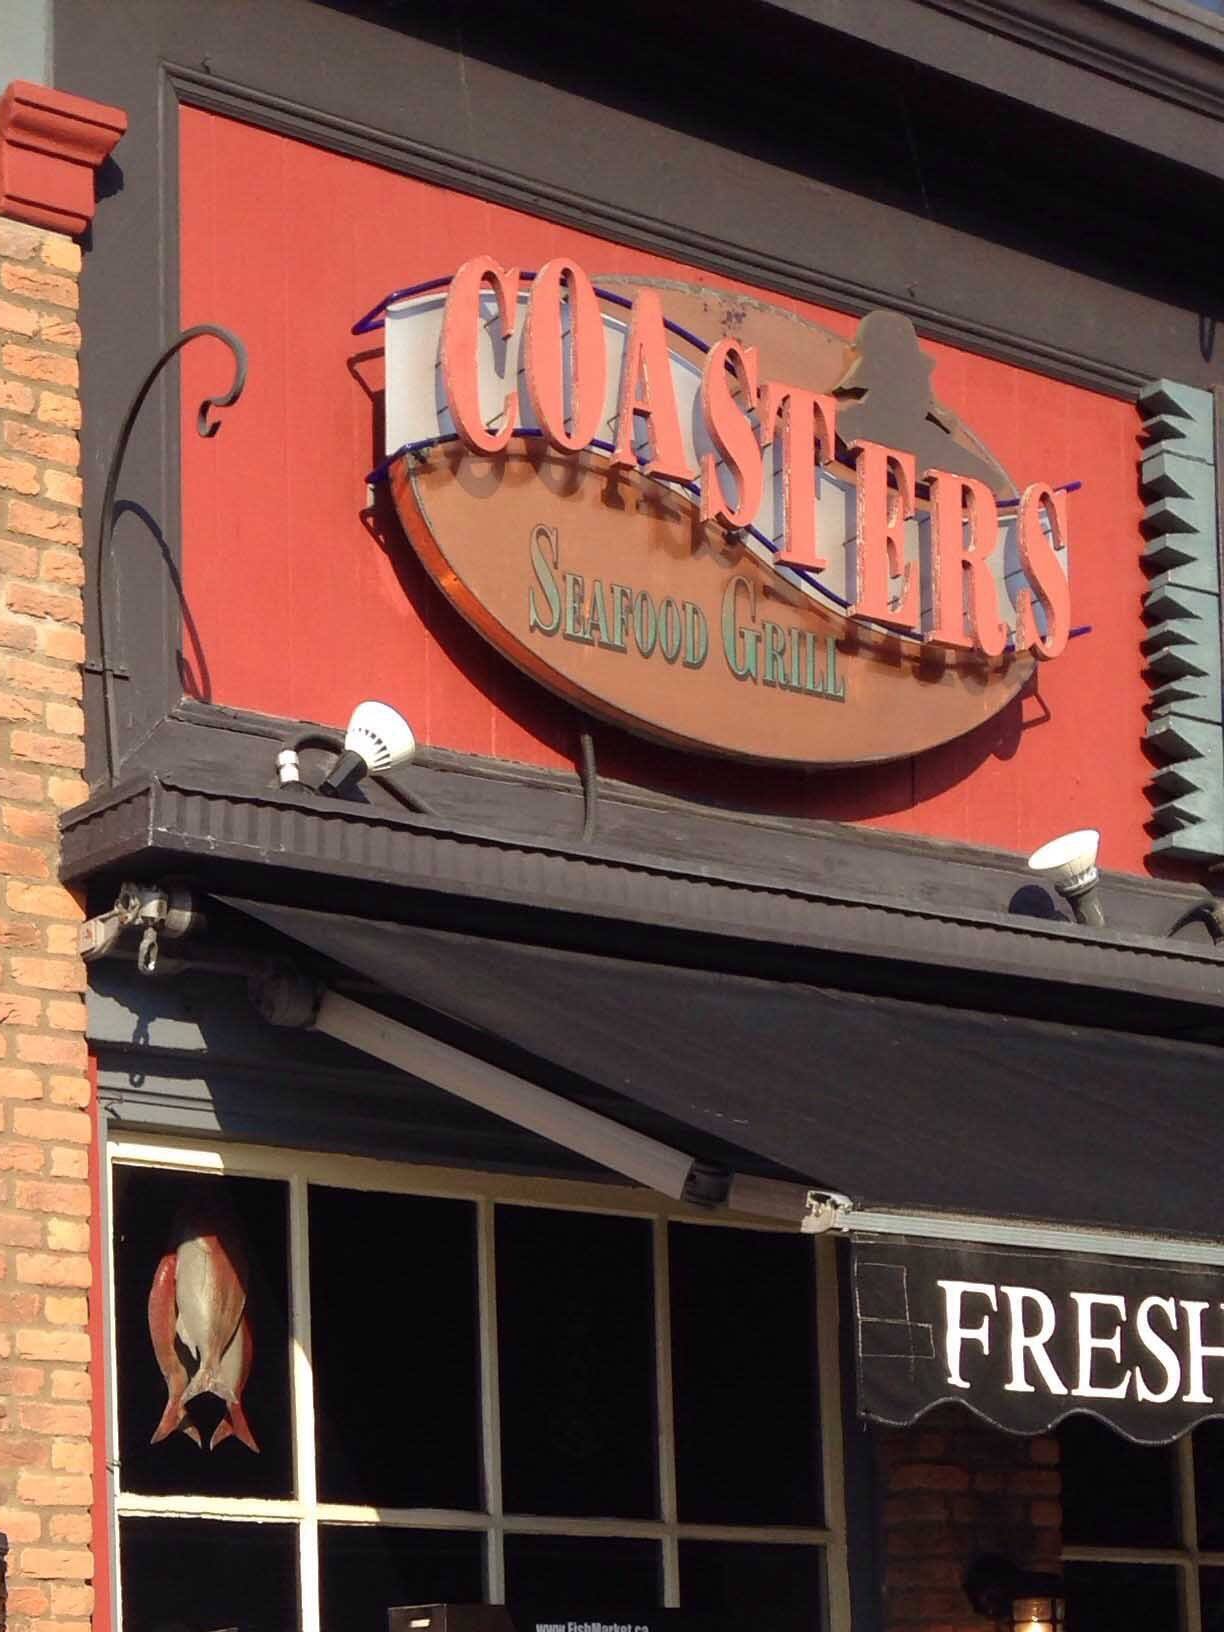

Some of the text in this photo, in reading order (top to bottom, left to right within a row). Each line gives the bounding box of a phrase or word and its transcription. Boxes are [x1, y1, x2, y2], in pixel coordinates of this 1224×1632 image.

[440, 254, 1073, 661] COASTERS
[528, 522, 847, 702] SEAFOOD GRILL
